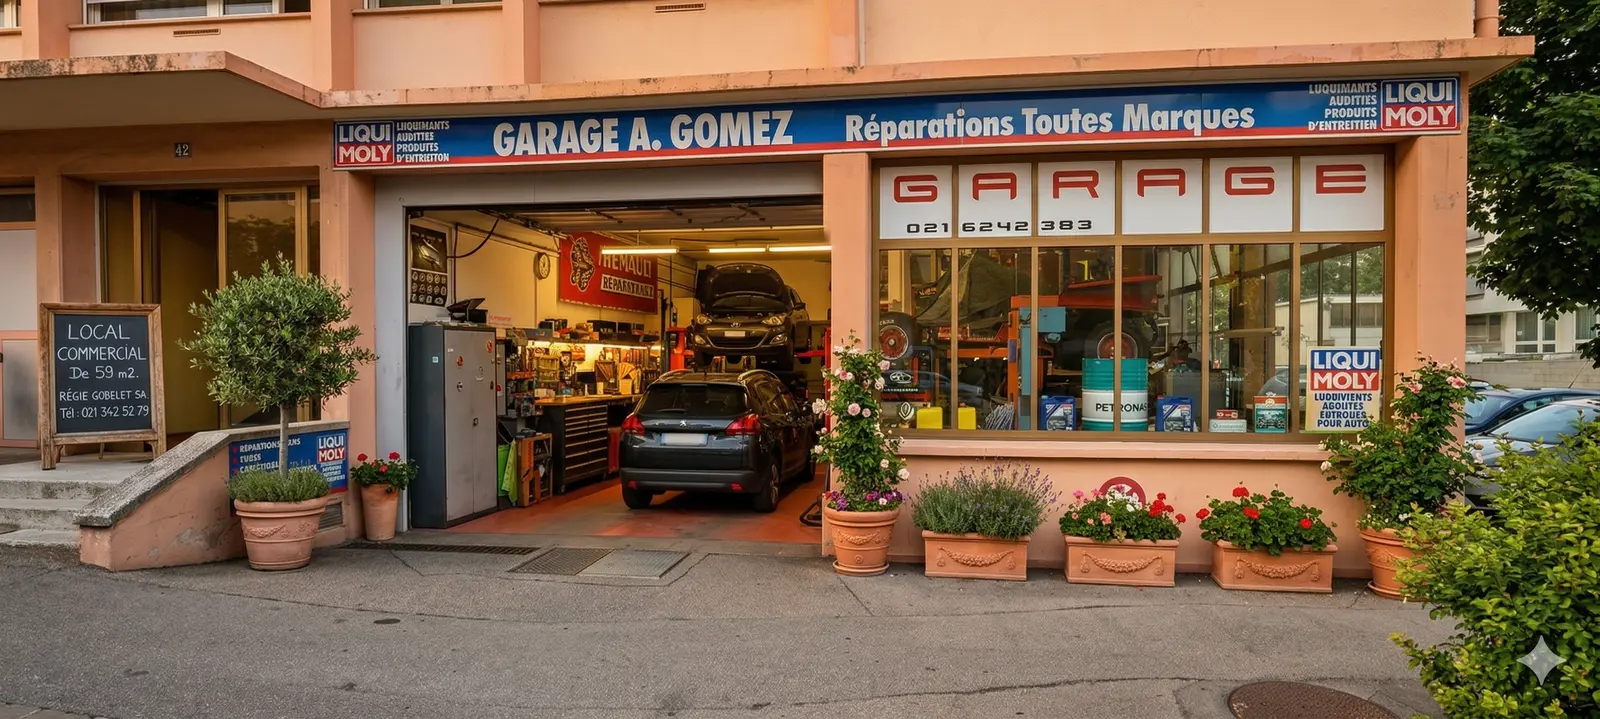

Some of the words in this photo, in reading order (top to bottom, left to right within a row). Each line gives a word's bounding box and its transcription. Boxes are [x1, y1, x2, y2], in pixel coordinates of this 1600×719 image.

[1385, 82, 1451, 103] LIQUI
[1385, 105, 1454, 127] MOLY
[339, 124, 391, 143] LIQUI
[493, 118, 619, 157] GARAGE
[628, 117, 662, 152] A.
[670, 110, 794, 149] GOMEZ
[845, 108, 1014, 147] Réparations
[1021, 107, 1113, 136] Toutes
[1122, 103, 1255, 136] Marques
[175, 143, 189, 156] 42
[339, 145, 392, 163] MOLY
[893, 163, 1367, 203] GARAGE
[906, 222, 949, 233] 021
[962, 221, 1029, 232] 6242
[1041, 219, 1092, 231] 383
[68, 323, 131, 340] LOCAL
[57, 344, 146, 361] COMMERCIAL
[1313, 351, 1376, 370] LIQUI
[69, 366, 89, 379] De
[95, 365, 113, 379] 59
[118, 367, 139, 379] m2.
[1313, 371, 1378, 390] MOLY
[59, 388, 88, 401] RÉGIE
[91, 390, 132, 401] GOBELET
[81, 406, 97, 418] 021
[100, 406, 119, 418] 342
[122, 405, 134, 417] 52
[137, 404, 149, 416] 79
[1317, 419, 1342, 428] POUR
[318, 435, 344, 449] LIQUI
[318, 447, 345, 462] MOLY
